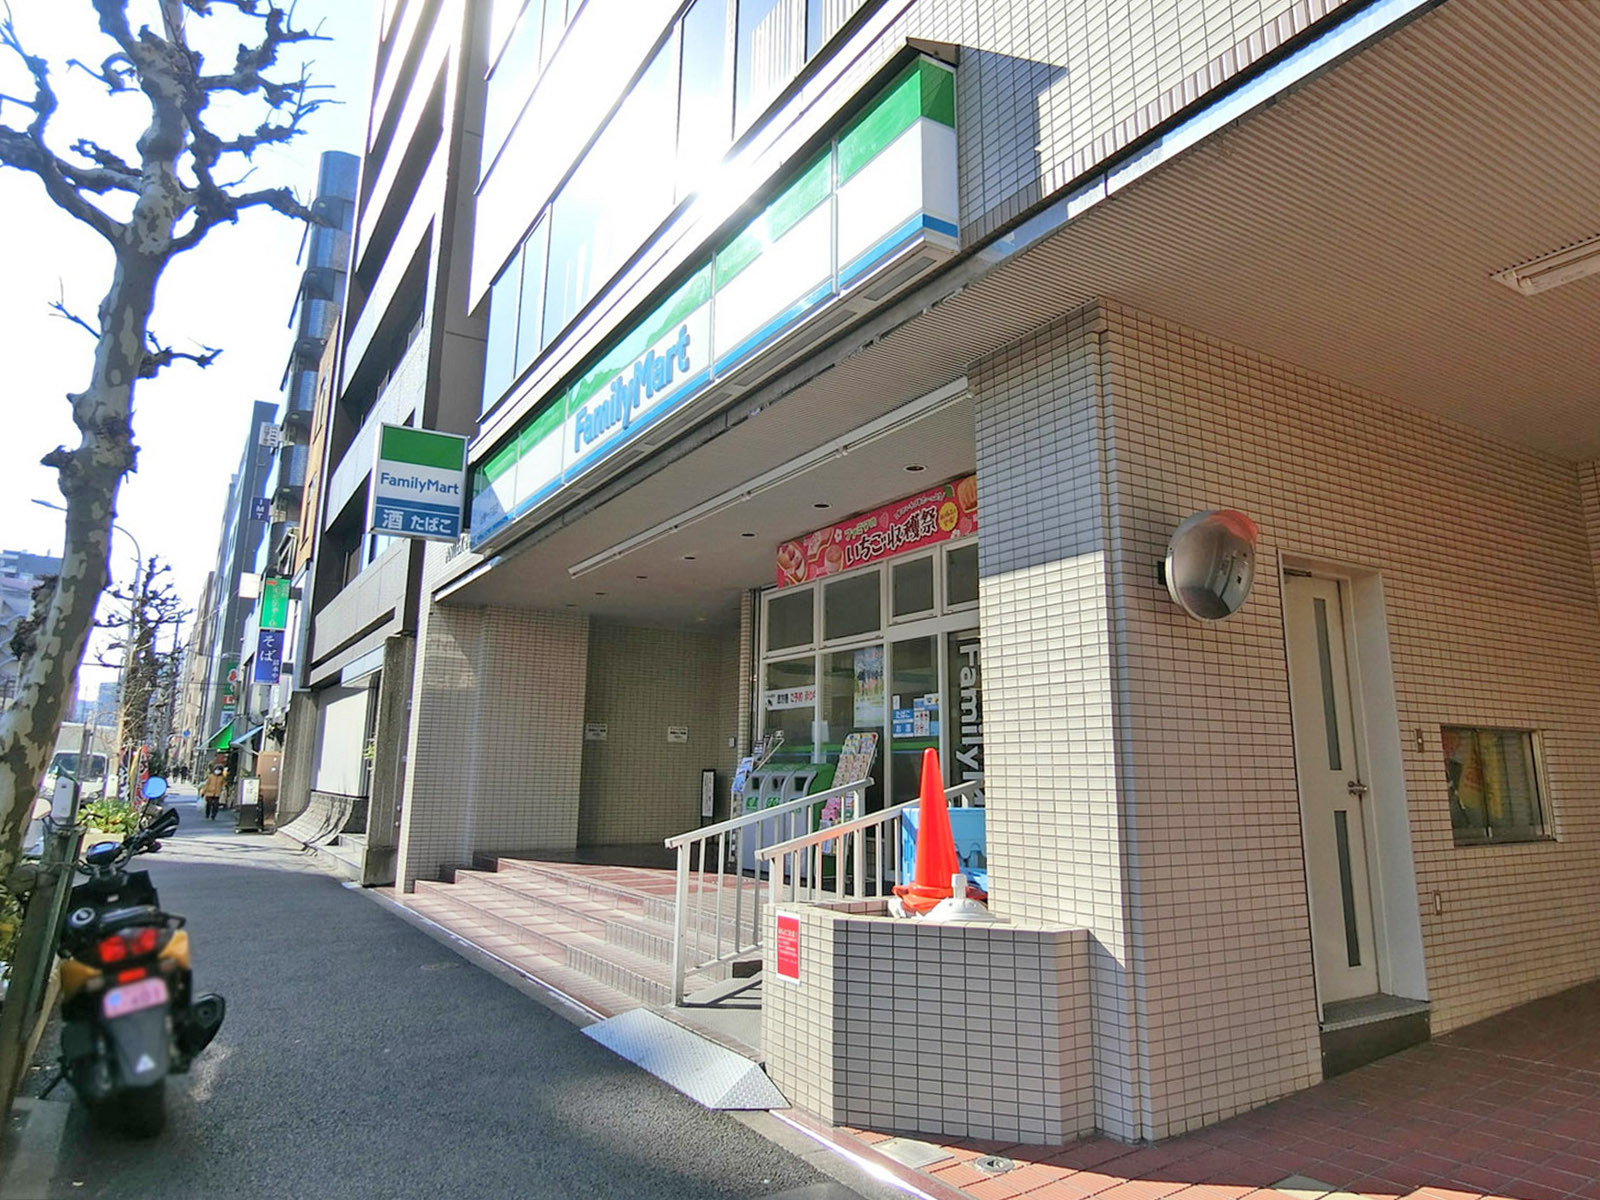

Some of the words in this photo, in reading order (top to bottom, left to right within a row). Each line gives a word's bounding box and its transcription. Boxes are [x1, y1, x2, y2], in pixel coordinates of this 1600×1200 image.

[574, 324, 690, 453] FamilyMart
[380, 471, 460, 495] FamilyMart
[381, 508, 405, 530] 酒
[410, 514, 452, 533] たばこ
[845, 505, 938, 566] いちご収穫祭
[258, 634, 277, 662] そば
